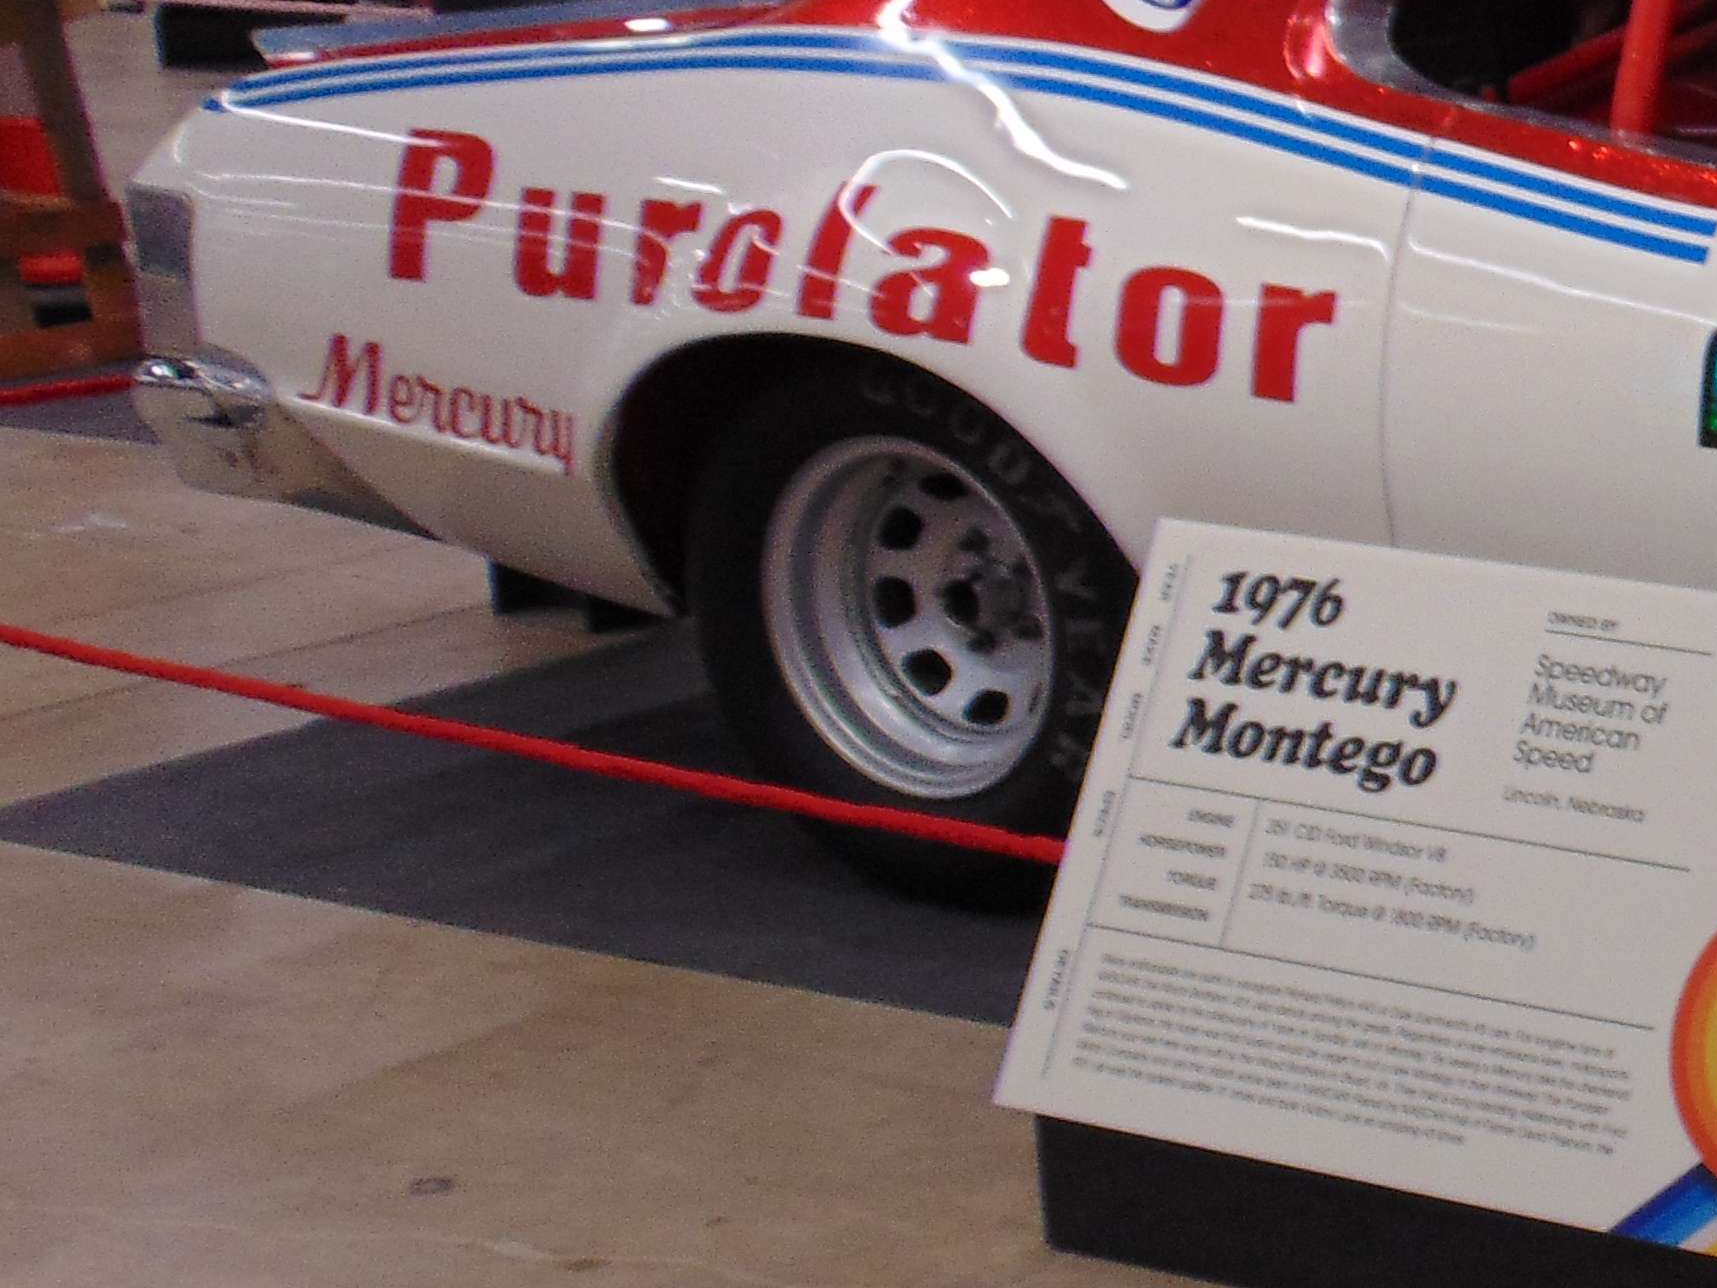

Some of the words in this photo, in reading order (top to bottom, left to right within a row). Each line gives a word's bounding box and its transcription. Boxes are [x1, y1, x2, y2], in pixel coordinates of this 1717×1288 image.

[389, 128, 1338, 402] Purolator
[297, 333, 577, 477] Mercury
[1211, 569, 1345, 630] 1976
[1187, 628, 1459, 730] Mercury
[1526, 682, 1638, 721] Museum
[1638, 699, 1670, 726] of
[1532, 653, 1669, 699] Speedway
[1168, 696, 1438, 794] Montego
[1510, 739, 1596, 779] Speed
[1519, 710, 1644, 752] American
